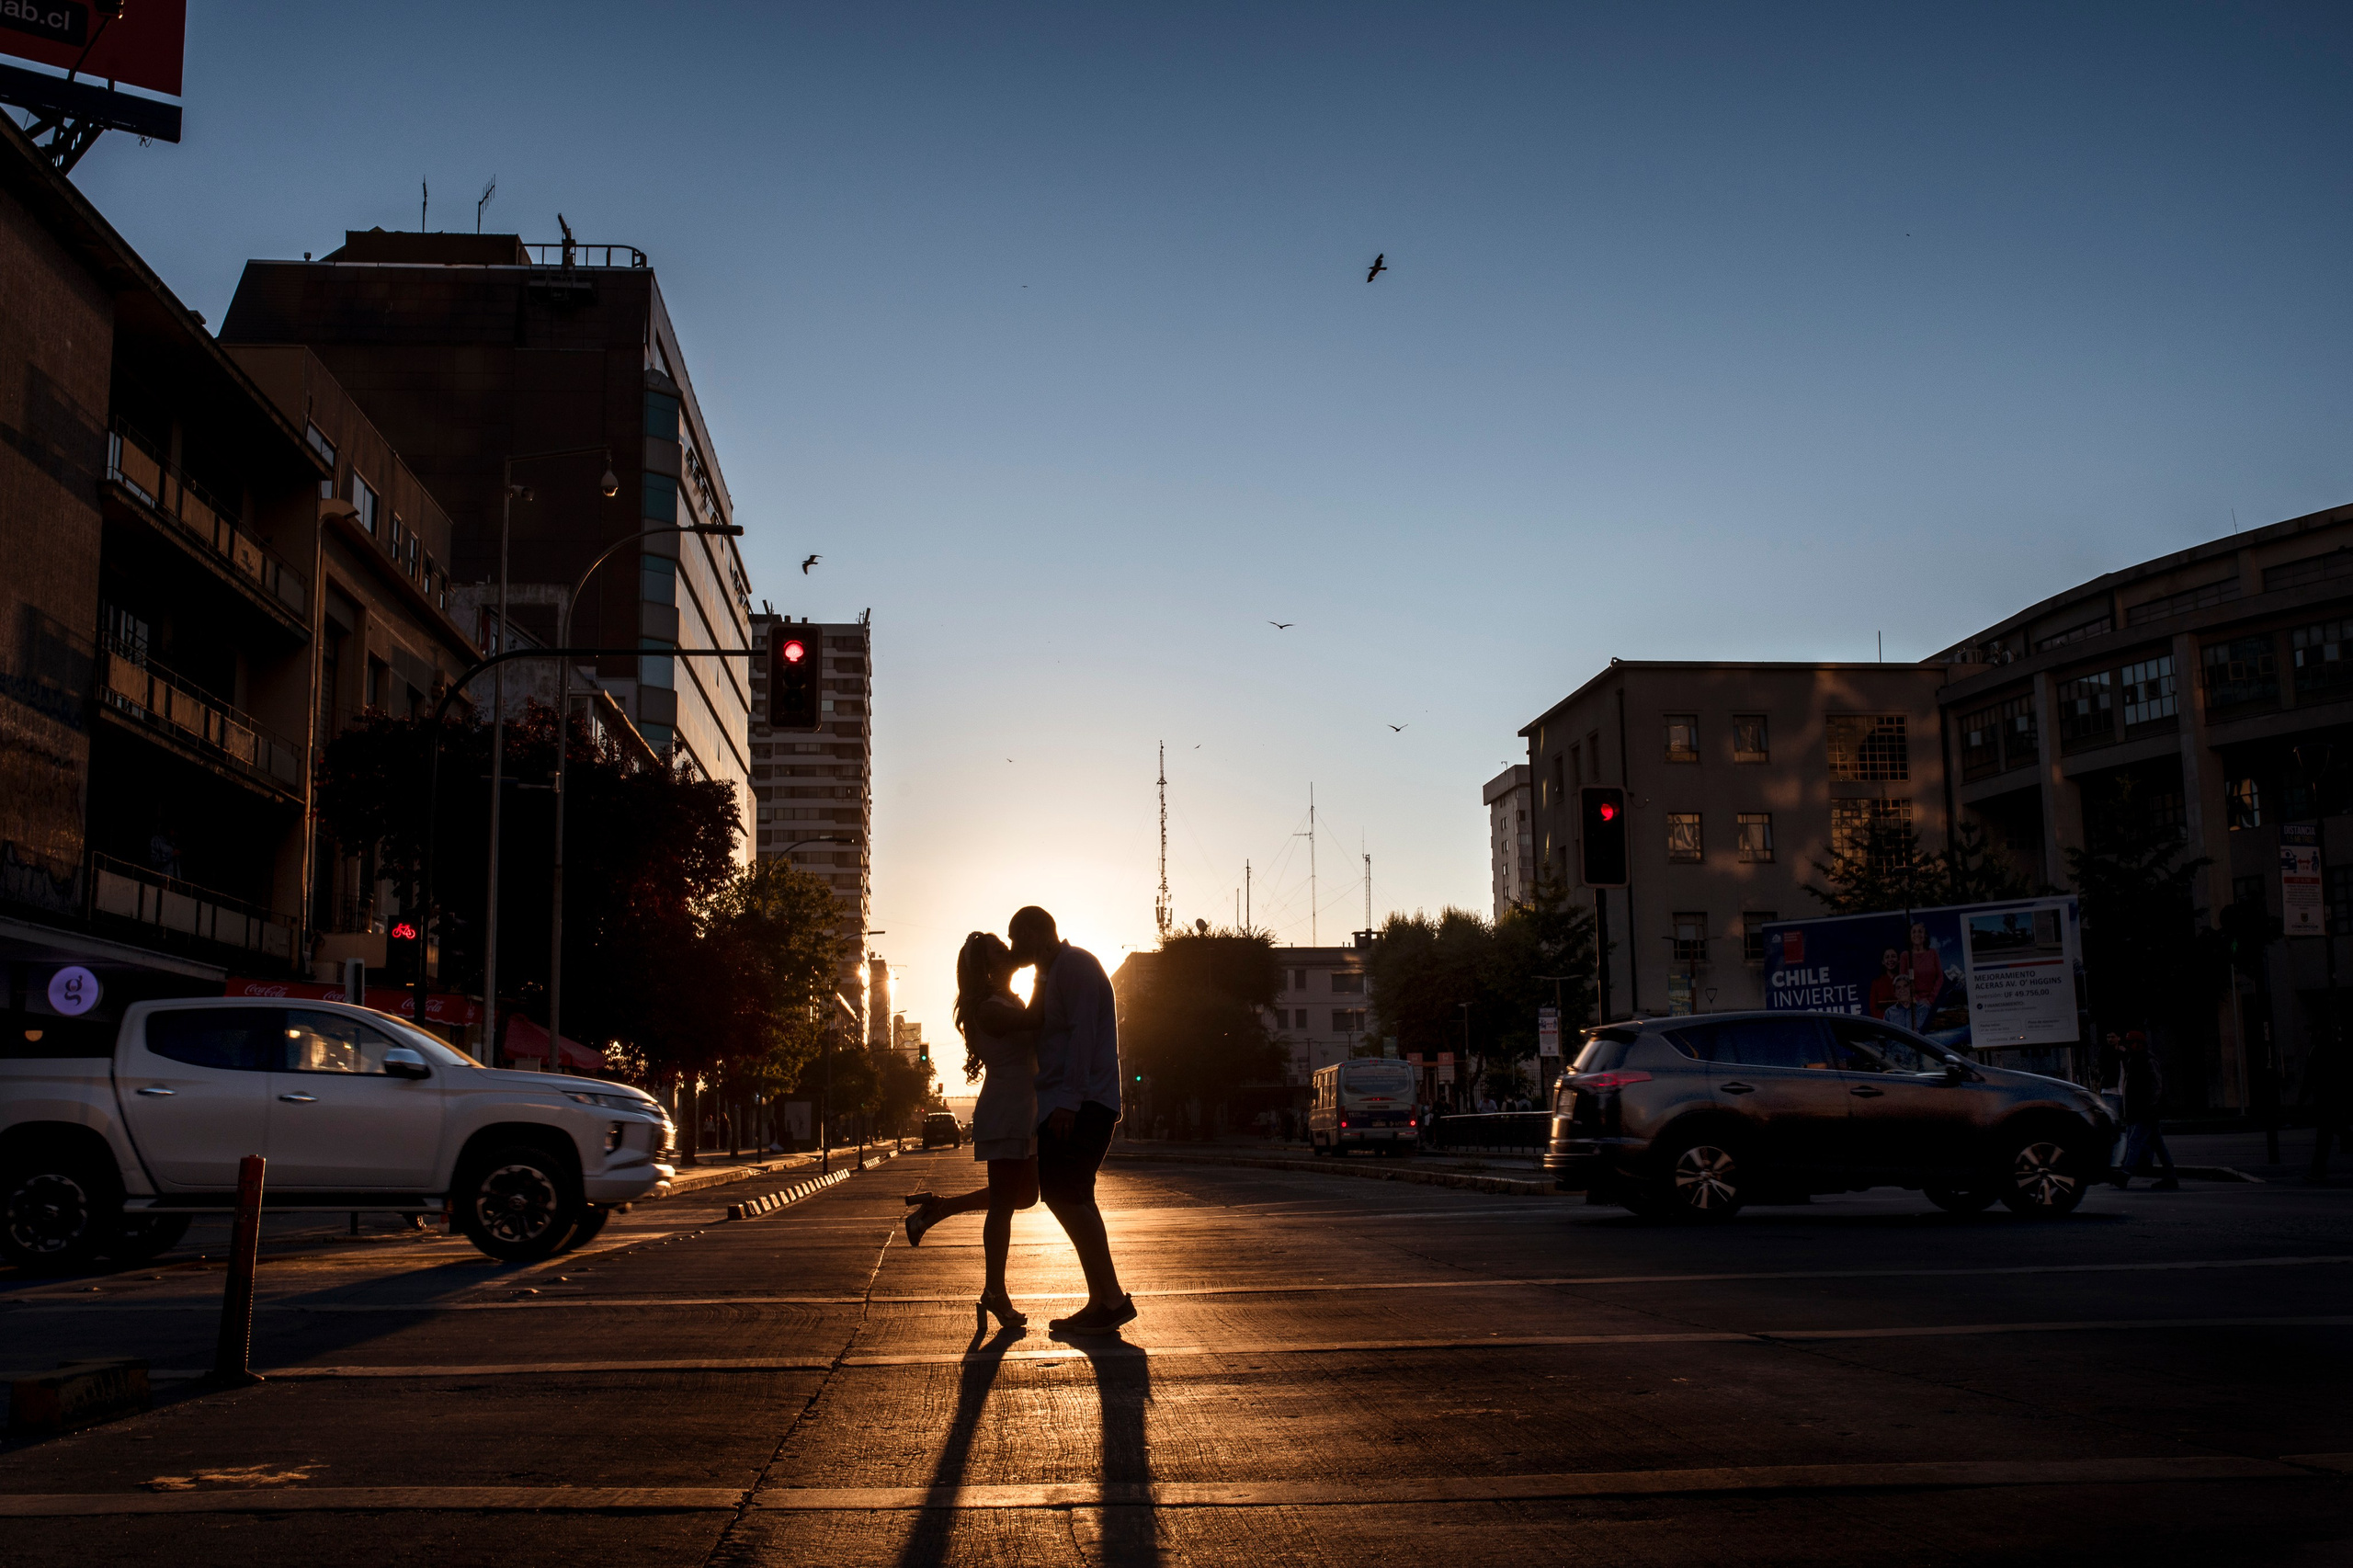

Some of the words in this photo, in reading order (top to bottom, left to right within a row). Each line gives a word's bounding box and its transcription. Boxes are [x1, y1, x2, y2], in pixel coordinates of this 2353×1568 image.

[0, 0, 71, 31] ab.cl
[2283, 825, 2315, 835] DISTANCIA
[1771, 966, 1830, 988] CHILE
[1974, 971, 2036, 982] MEJORAMIENTO
[1974, 982, 2004, 990] ACERAS
[2005, 980, 2017, 988] AV.
[2029, 976, 2062, 984] HIGGINS
[64, 974, 84, 1006] g
[1773, 984, 1859, 1008] INVIERTE
[2015, 989, 2049, 997] 49.756,00
